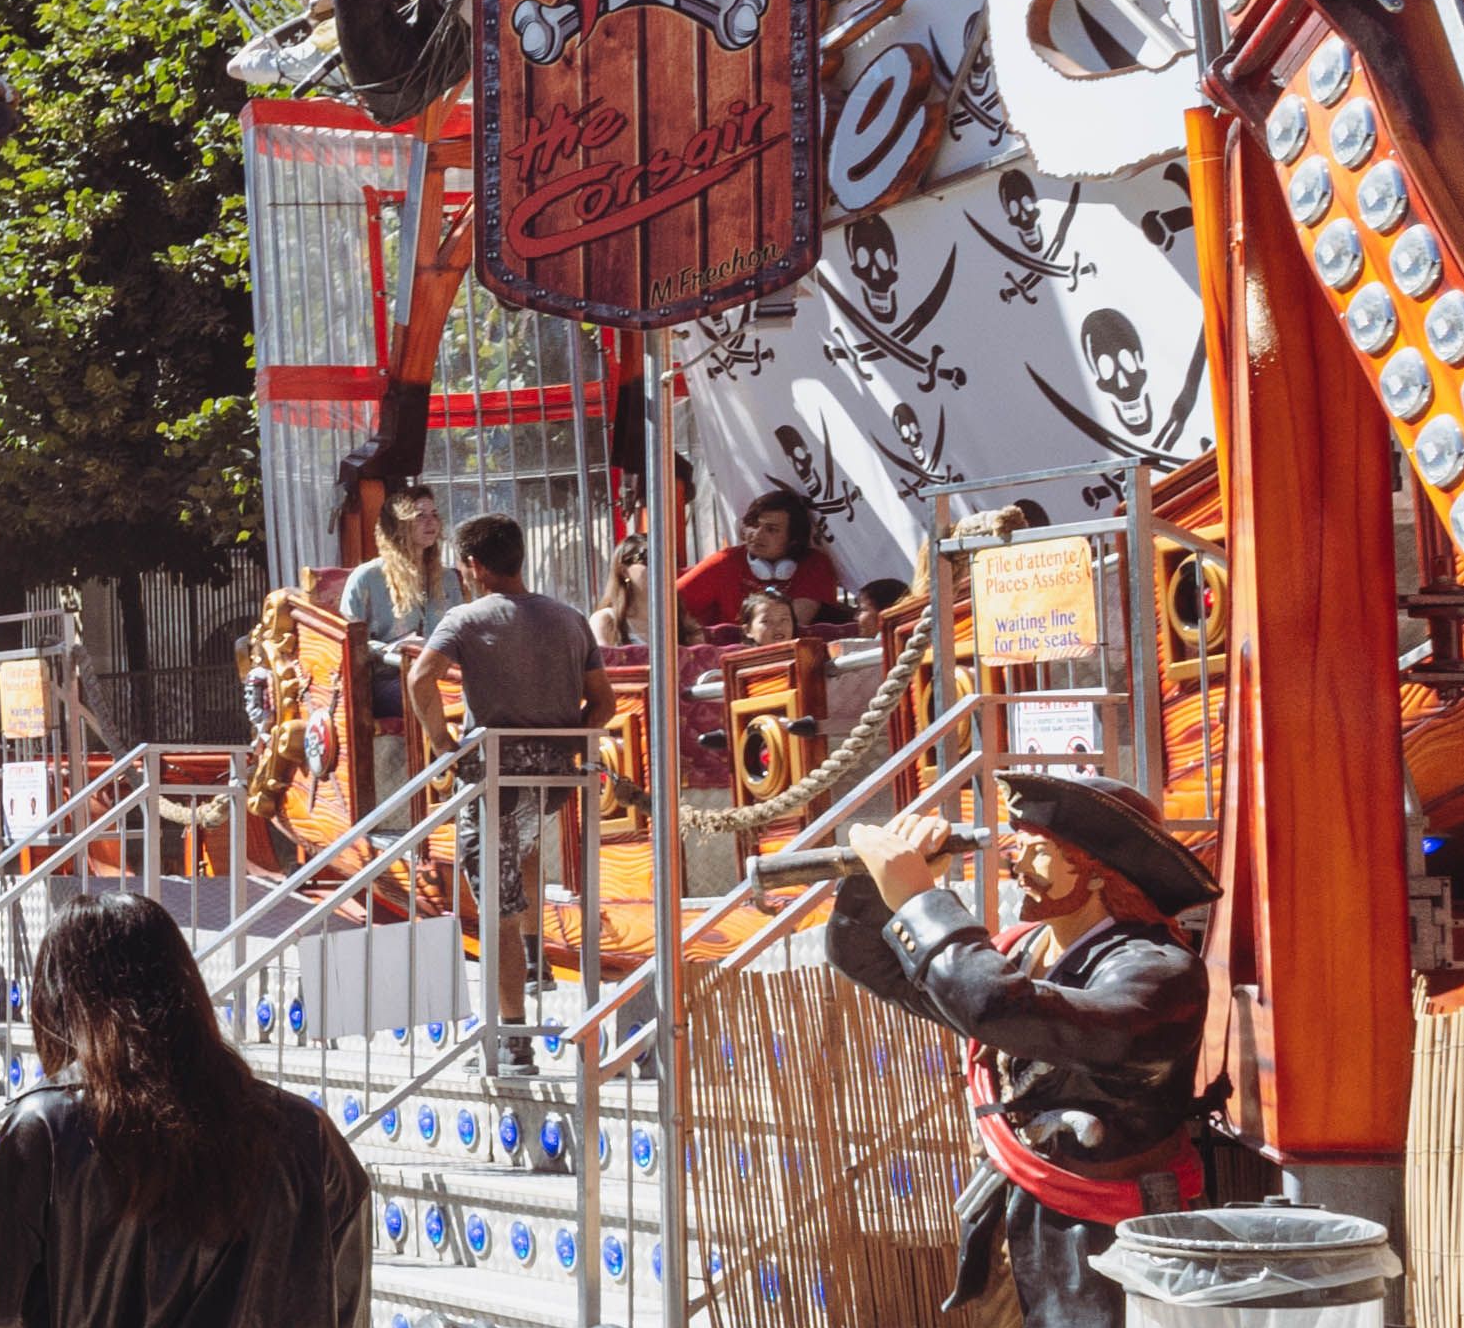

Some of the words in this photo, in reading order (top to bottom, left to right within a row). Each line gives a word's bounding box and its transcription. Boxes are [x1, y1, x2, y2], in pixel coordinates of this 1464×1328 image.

[506, 96, 629, 182] the
[506, 101, 791, 260] Corsair
[986, 556, 1012, 575] File
[1015, 550, 1077, 571] d'attente
[985, 577, 1029, 596] Places
[1032, 569, 1081, 588] Assises
[995, 612, 1047, 633] Waiting
[1050, 609, 1076, 626] line
[994, 635, 1013, 655] for
[1018, 633, 1040, 651] the
[1044, 631, 1080, 648] seats
